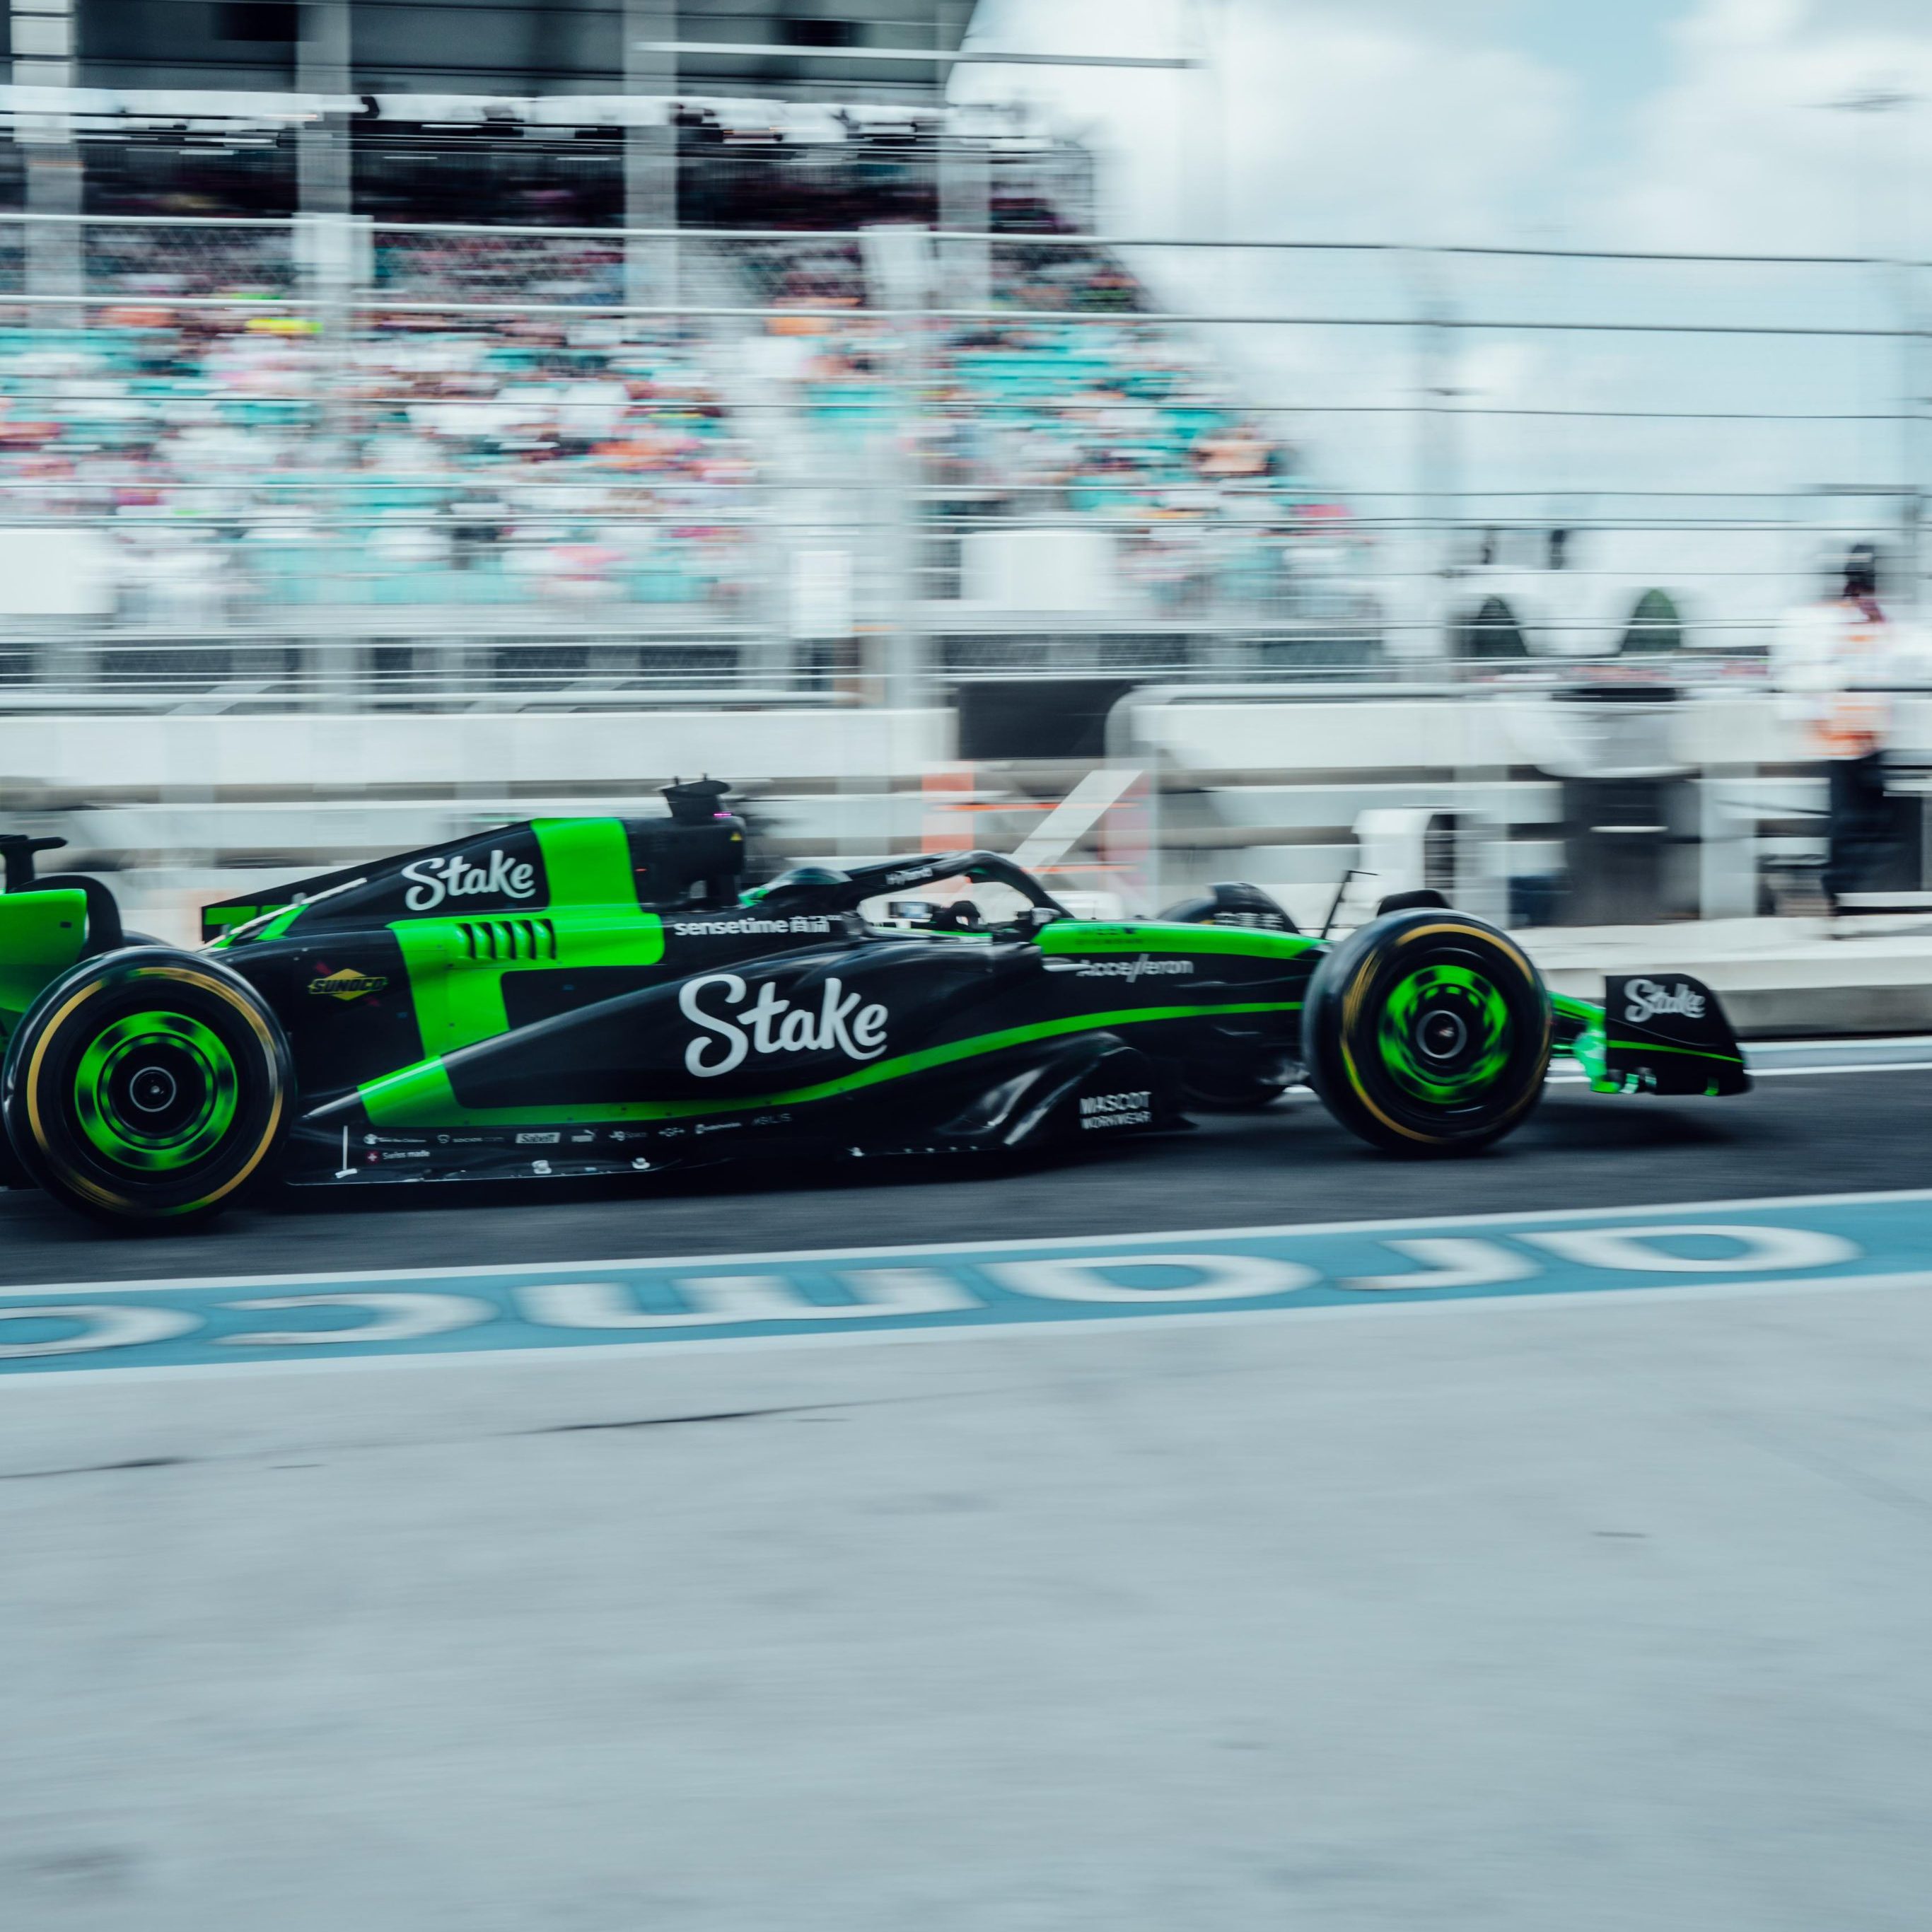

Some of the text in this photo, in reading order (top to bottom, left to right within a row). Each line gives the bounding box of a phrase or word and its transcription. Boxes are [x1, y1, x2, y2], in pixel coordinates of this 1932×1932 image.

[401, 850, 535, 911] Stake
[673, 917, 788, 936] sensetime
[310, 977, 388, 994] SUNOCO
[1624, 979, 1706, 1023] Stake
[679, 974, 888, 1077] Stake
[1079, 1091, 1152, 1115] MASCOT
[0, 1223, 1865, 1360] aramco
